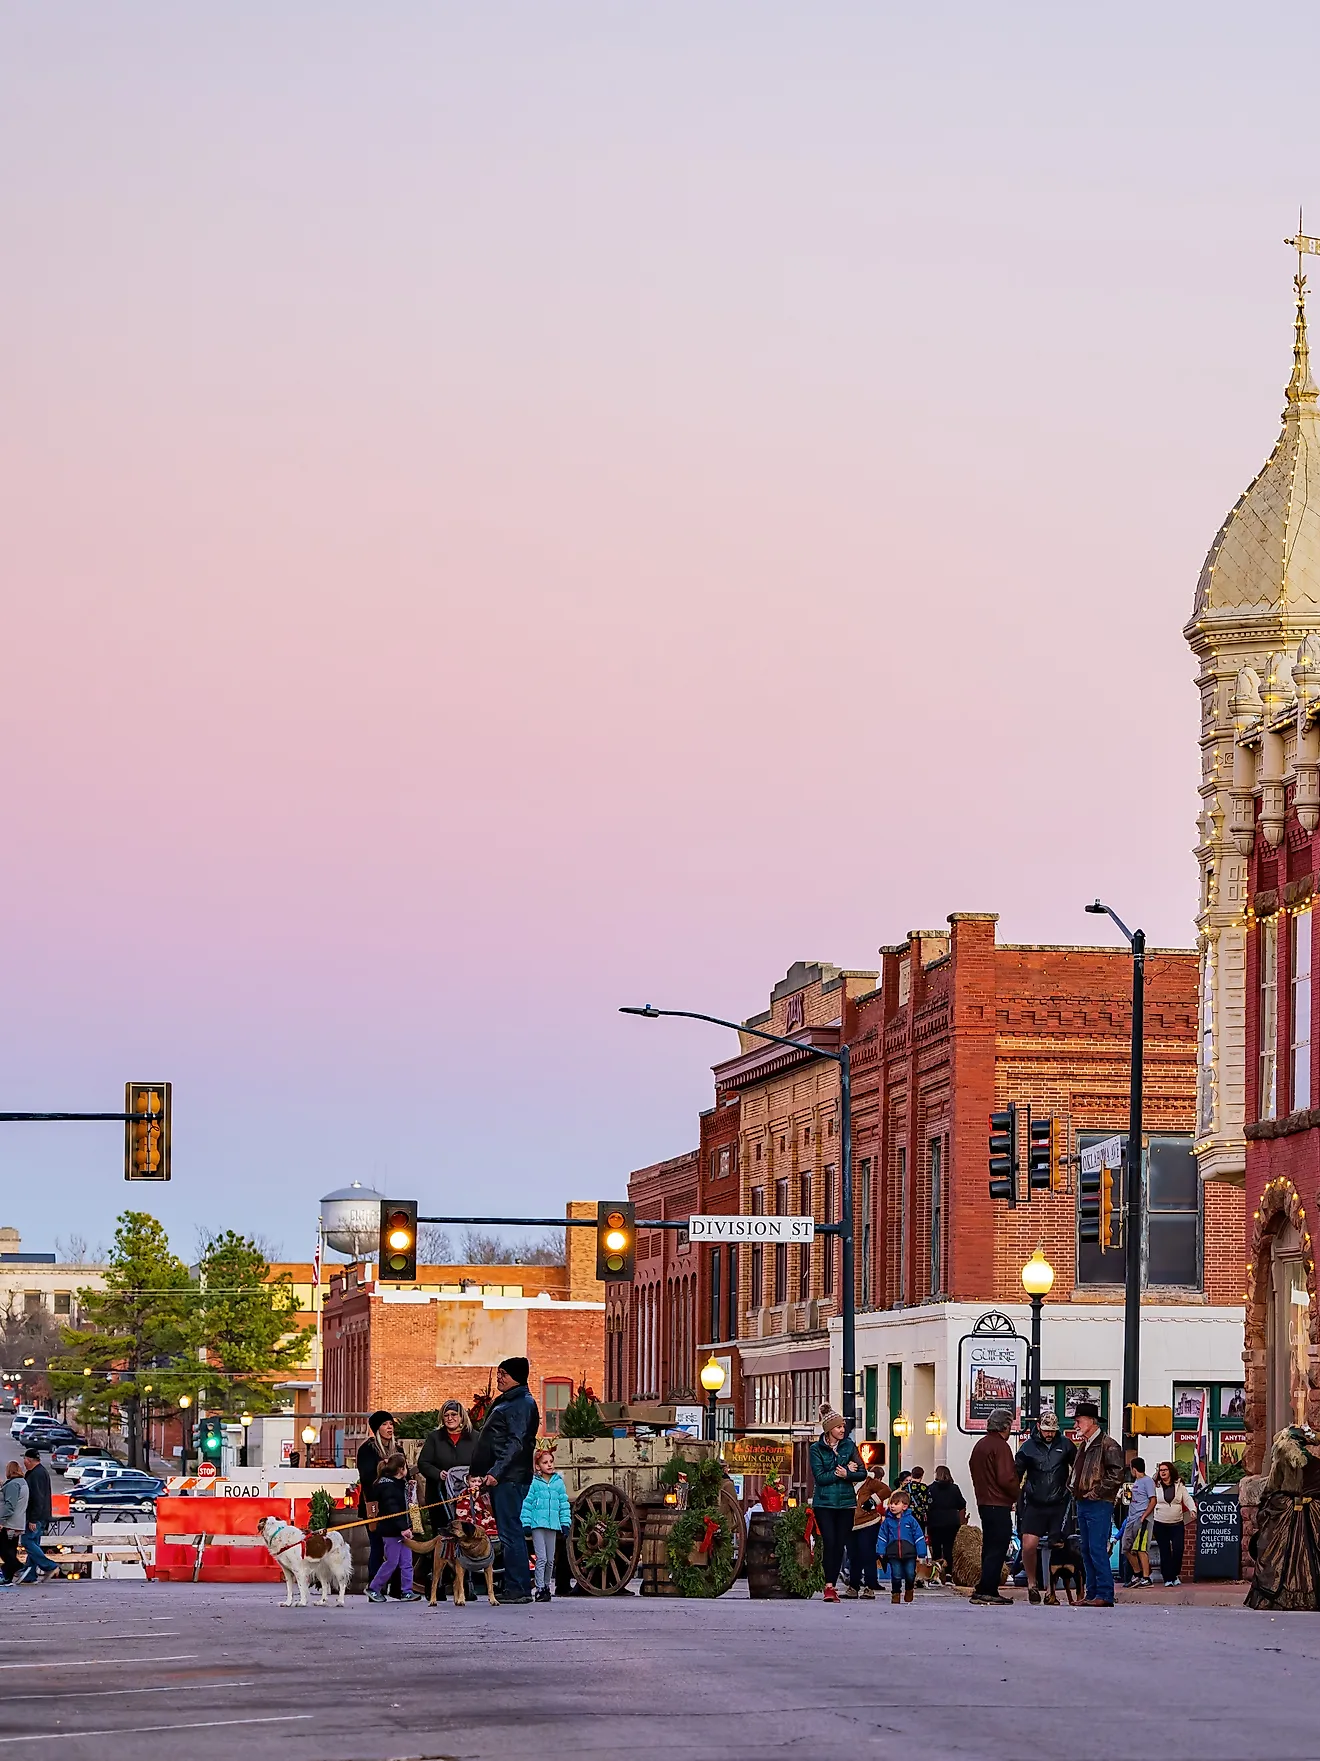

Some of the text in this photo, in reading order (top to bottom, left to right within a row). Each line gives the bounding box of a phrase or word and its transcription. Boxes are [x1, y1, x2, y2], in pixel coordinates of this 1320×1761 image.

[691, 1220, 813, 1236] DIVISION ST
[971, 1348, 1016, 1363] GUTHRIE
[758, 1454, 785, 1463] CRAFT
[224, 1486, 260, 1497] ROAD
[1199, 1501, 1240, 1513] COUNTRY
[1200, 1513, 1238, 1525] CORNER
